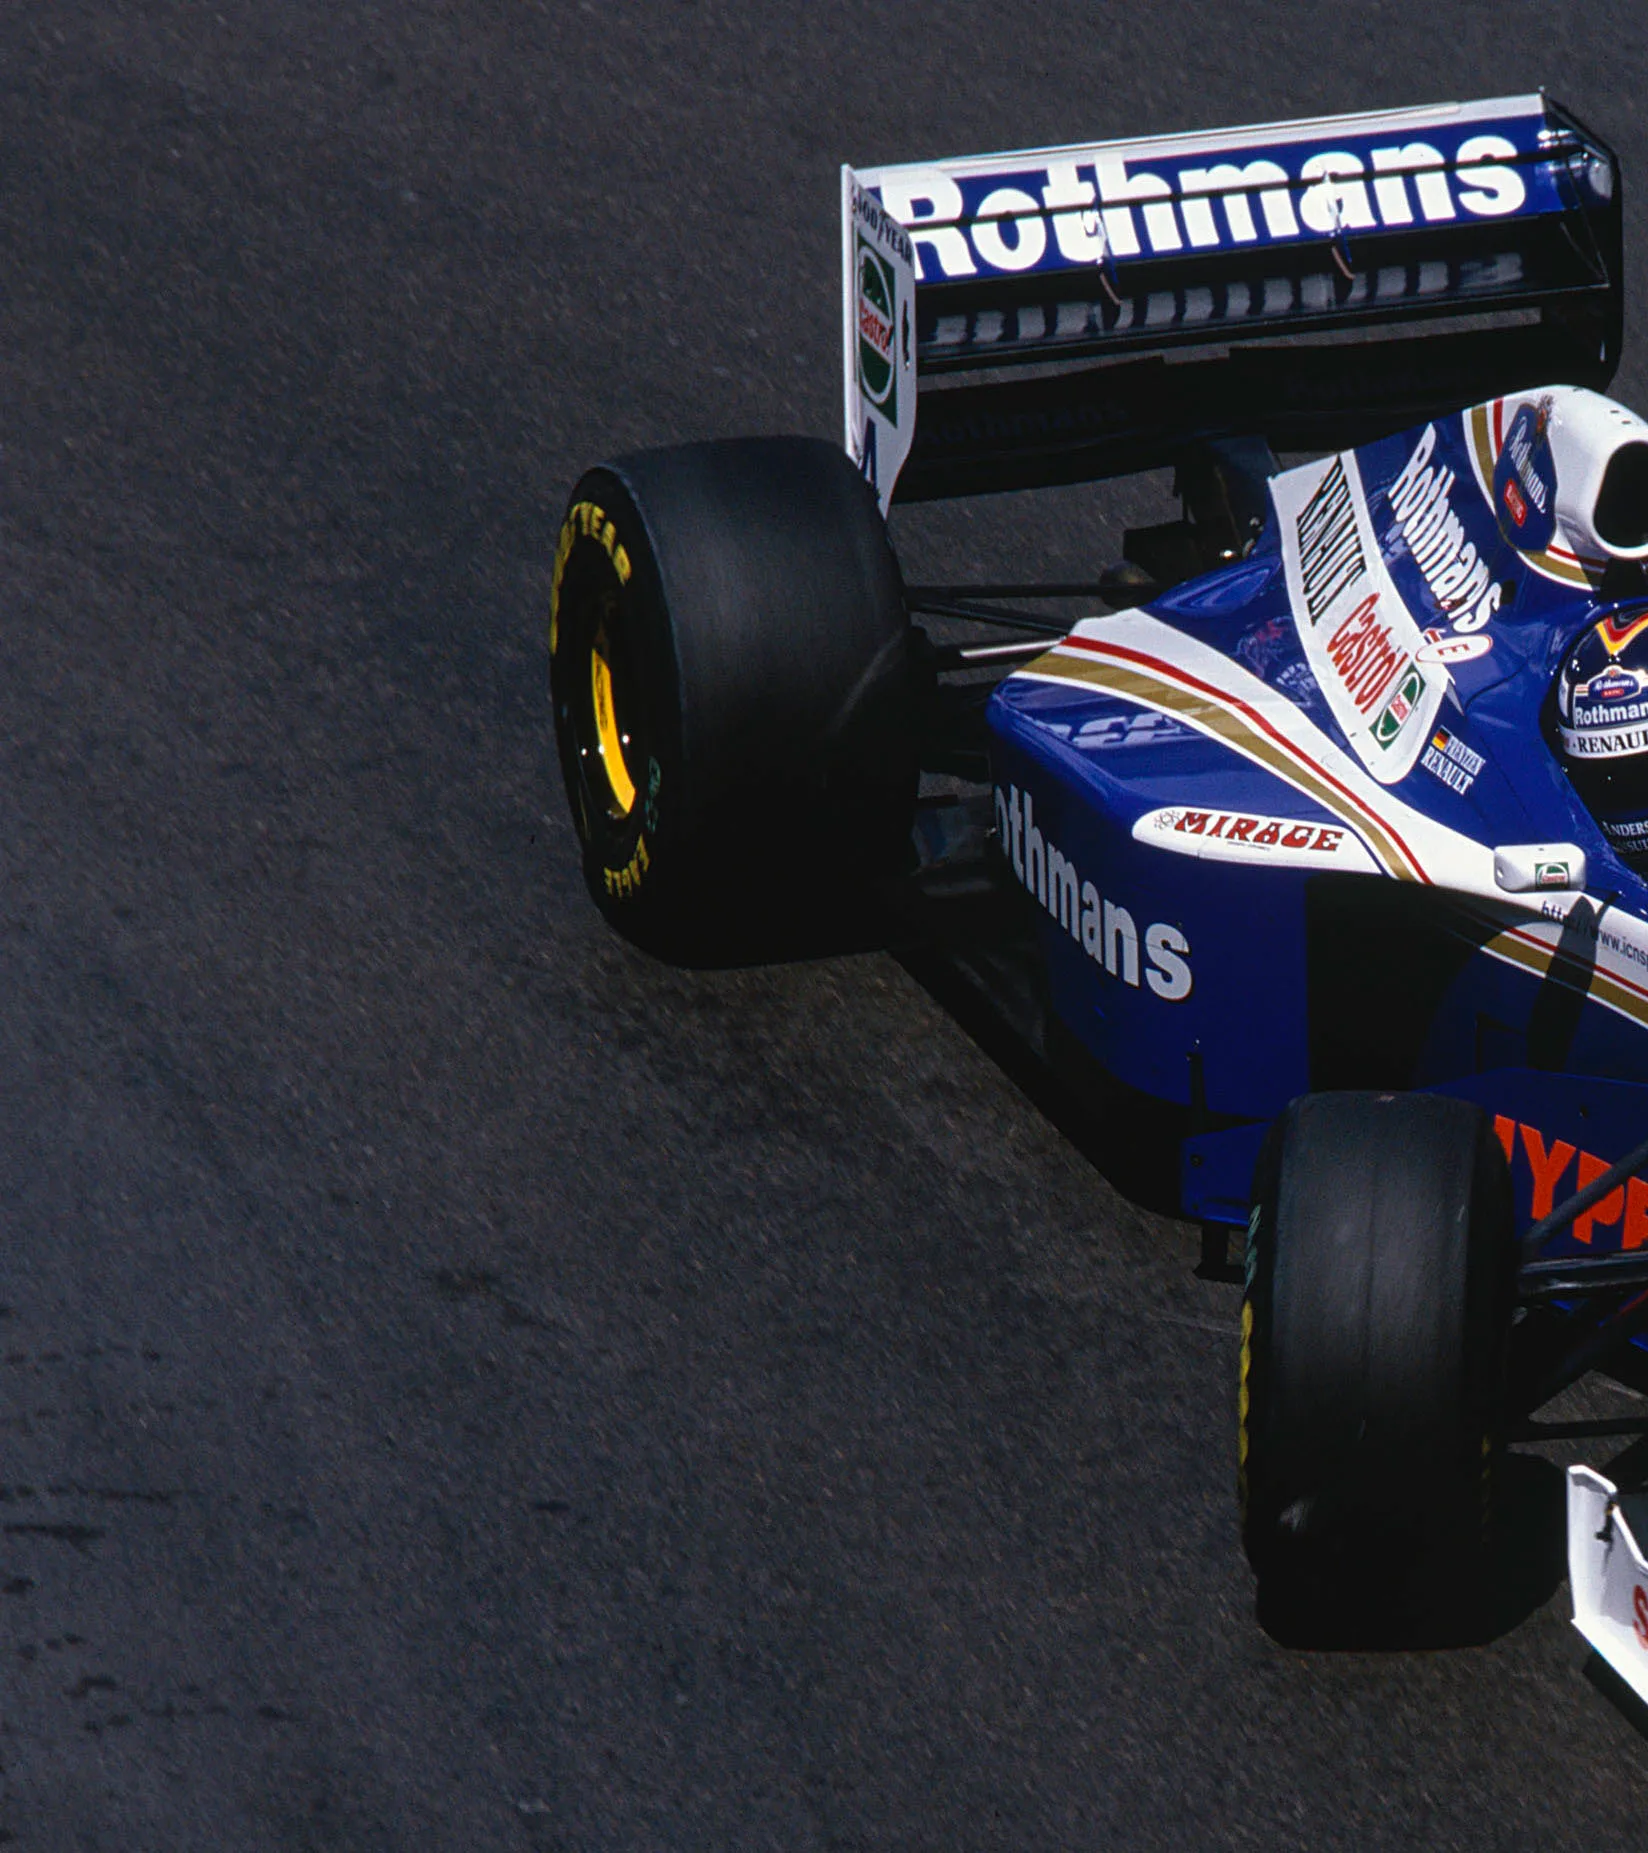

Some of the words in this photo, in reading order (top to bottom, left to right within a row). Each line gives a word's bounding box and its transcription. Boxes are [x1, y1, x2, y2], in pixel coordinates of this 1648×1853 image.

[878, 133, 1527, 282] Rothmans
[1296, 453, 1368, 628] RENAULT
[1388, 422, 1502, 633] Rothmans
[1326, 592, 1409, 714] Castrol
[1174, 811, 1344, 851] MIRAGE
[1420, 745, 1474, 796] RENAULT
[994, 783, 1193, 1000] othmans
